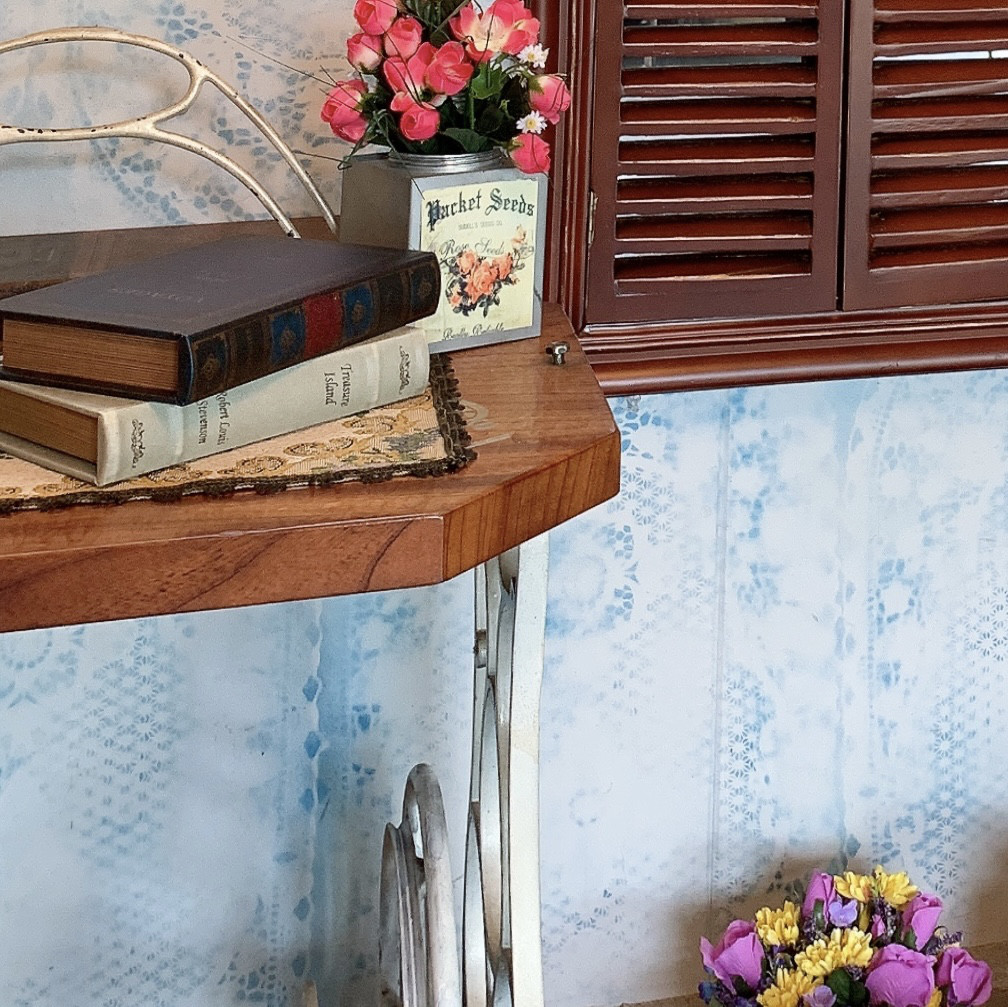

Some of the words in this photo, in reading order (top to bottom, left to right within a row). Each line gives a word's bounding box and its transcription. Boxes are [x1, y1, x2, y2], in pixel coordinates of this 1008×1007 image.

[426, 189, 482, 232] Packet
[485, 188, 535, 217] Seeds
[324, 372, 338, 405] Island
[341, 363, 354, 407] Treasure
[197, 401, 209, 444] Stevenson
[217, 422, 230, 445] Louis
